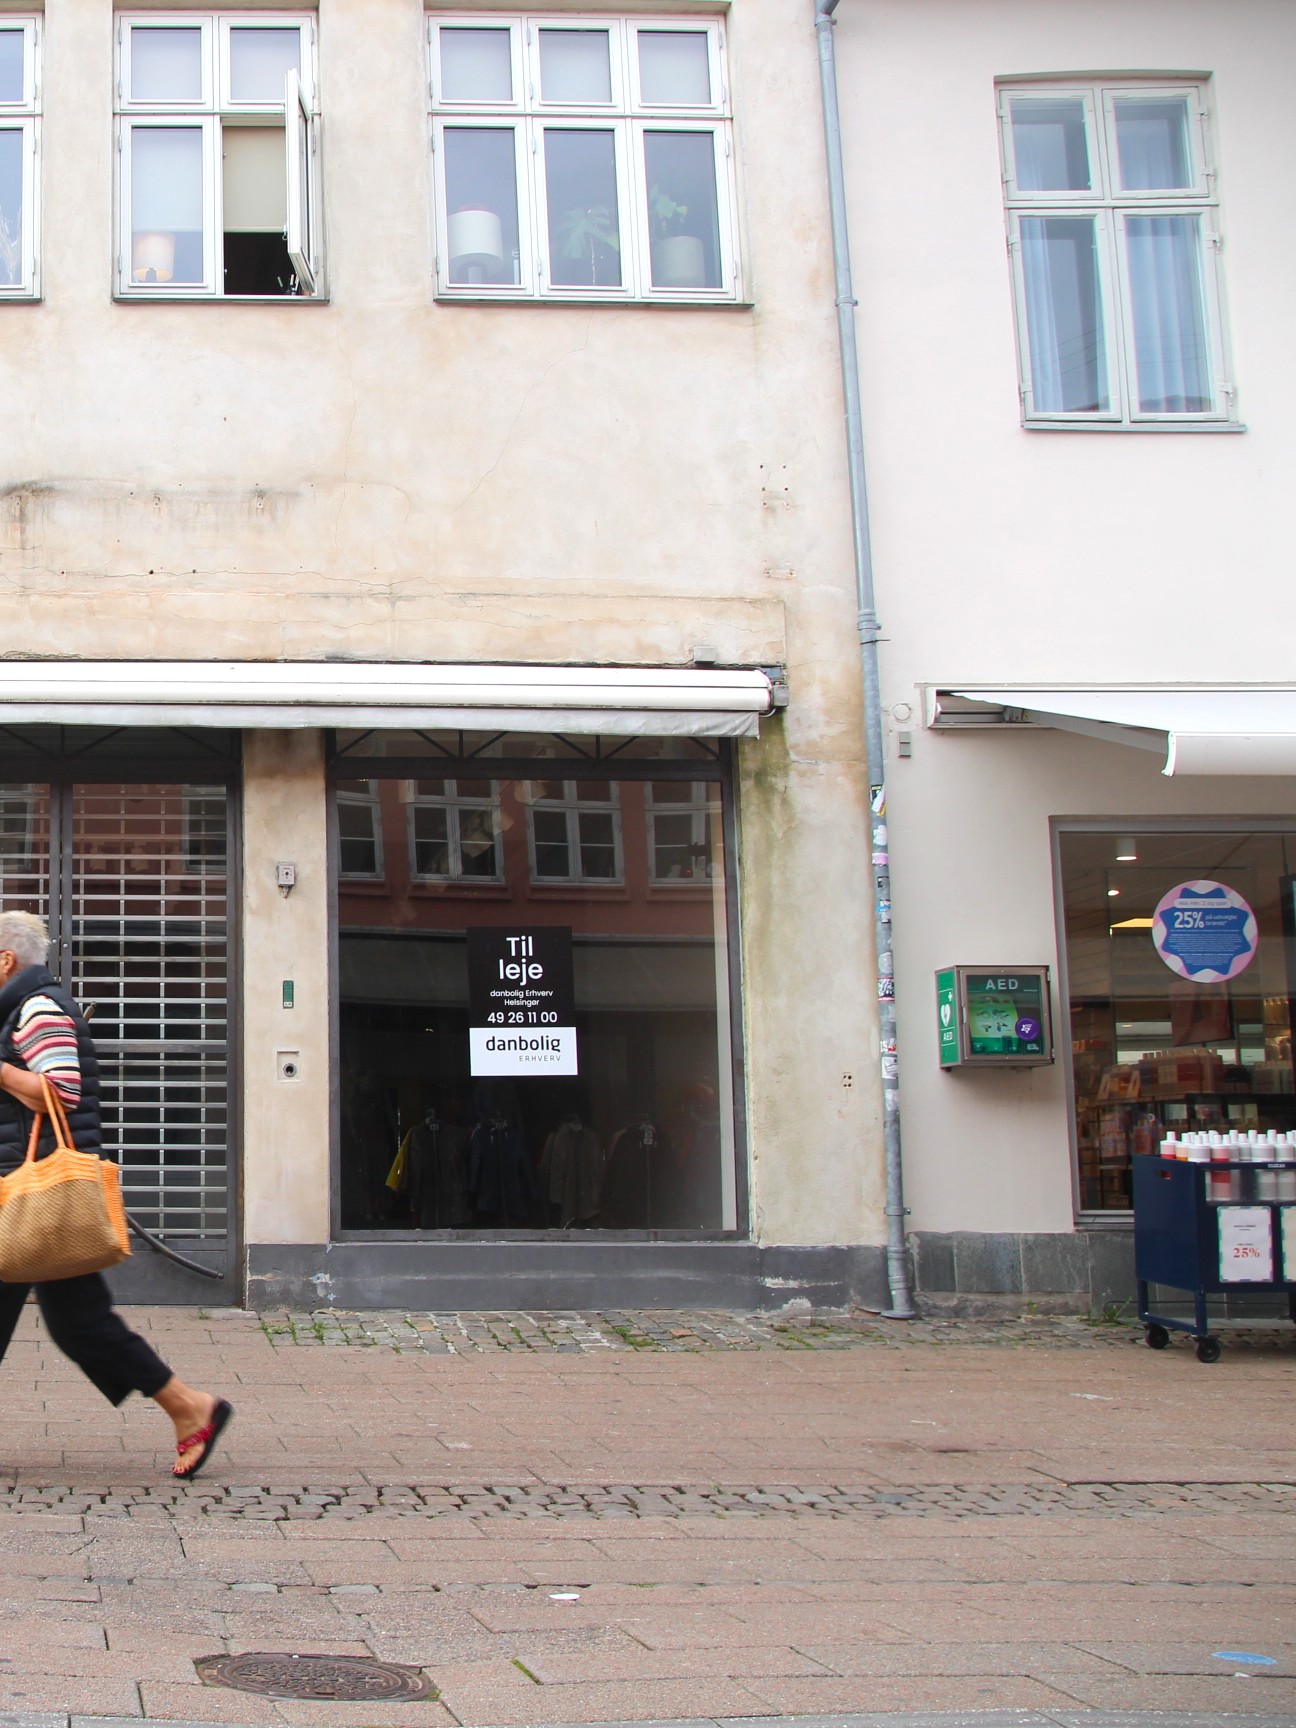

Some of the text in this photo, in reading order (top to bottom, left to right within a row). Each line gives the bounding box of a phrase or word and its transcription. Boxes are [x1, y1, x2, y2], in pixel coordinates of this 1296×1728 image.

[1173, 911, 1204, 928] 25%
[506, 935, 533, 956] Til
[499, 958, 543, 986] leje
[985, 979, 1019, 990] AED
[490, 990, 524, 998] danbolig
[504, 999, 540, 1007] Helsingør
[487, 1012, 558, 1023] 49 26 11 00
[943, 1031, 953, 1041] AED
[486, 1036, 561, 1052] danbolig
[1233, 1247, 1260, 1258] 25%
